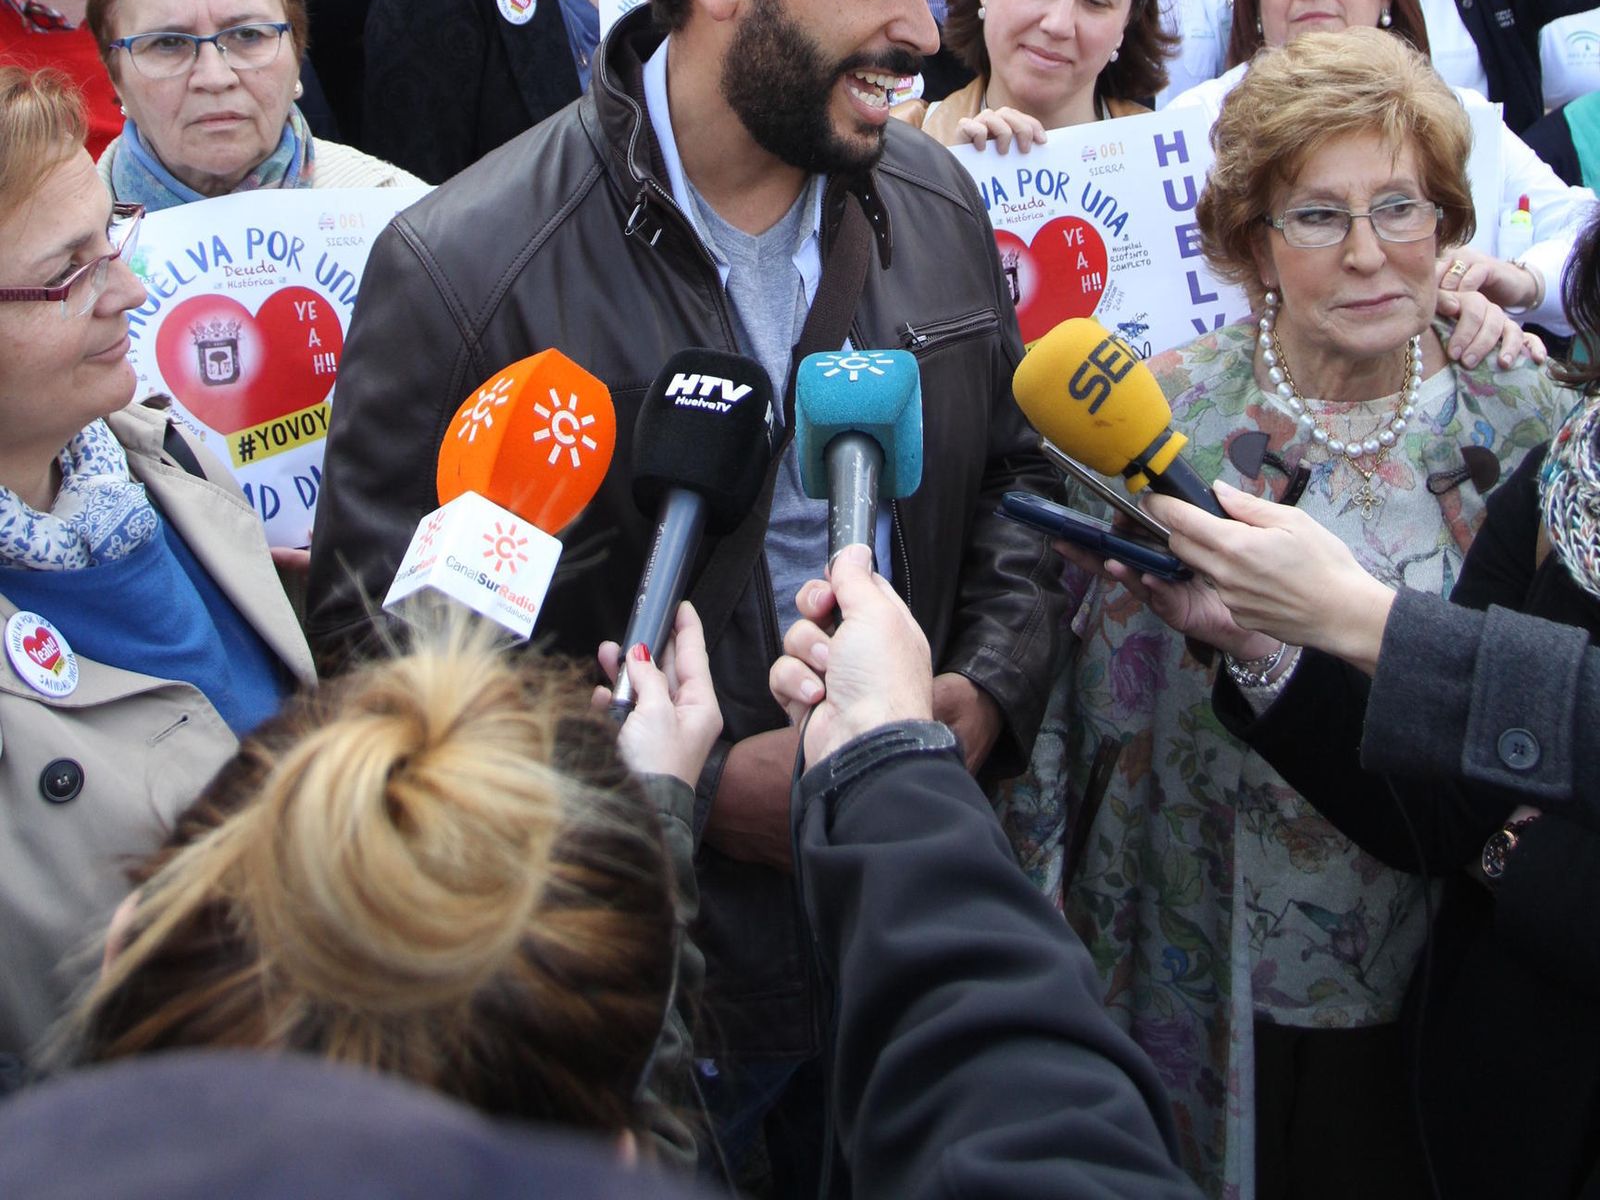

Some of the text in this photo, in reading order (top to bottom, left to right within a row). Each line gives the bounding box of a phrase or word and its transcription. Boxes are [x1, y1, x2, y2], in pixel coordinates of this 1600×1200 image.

[1100, 141, 1125, 158] 061
[1089, 163, 1126, 176] SIERRA
[1001, 196, 1046, 214] Deuda
[1016, 168, 1070, 204] POR
[1081, 181, 1129, 238] UNA
[339, 212, 366, 228] 061
[325, 236, 366, 247] SIERRA
[1063, 226, 1085, 247] YE
[246, 227, 305, 273] POR
[223, 260, 278, 278] Deuda
[1111, 259, 1152, 272] COMPLETO
[227, 277, 275, 289] Histórica
[1081, 272, 1102, 293] H!!
[294, 300, 318, 322] YE
[312, 352, 337, 376] H!!
[665, 372, 753, 402] HTV
[675, 395, 732, 413] HuelvaTV
[237, 406, 329, 462] #YOVOY
[446, 555, 536, 614] CanalSurRadio
[29, 636, 60, 664] Yeah!!
